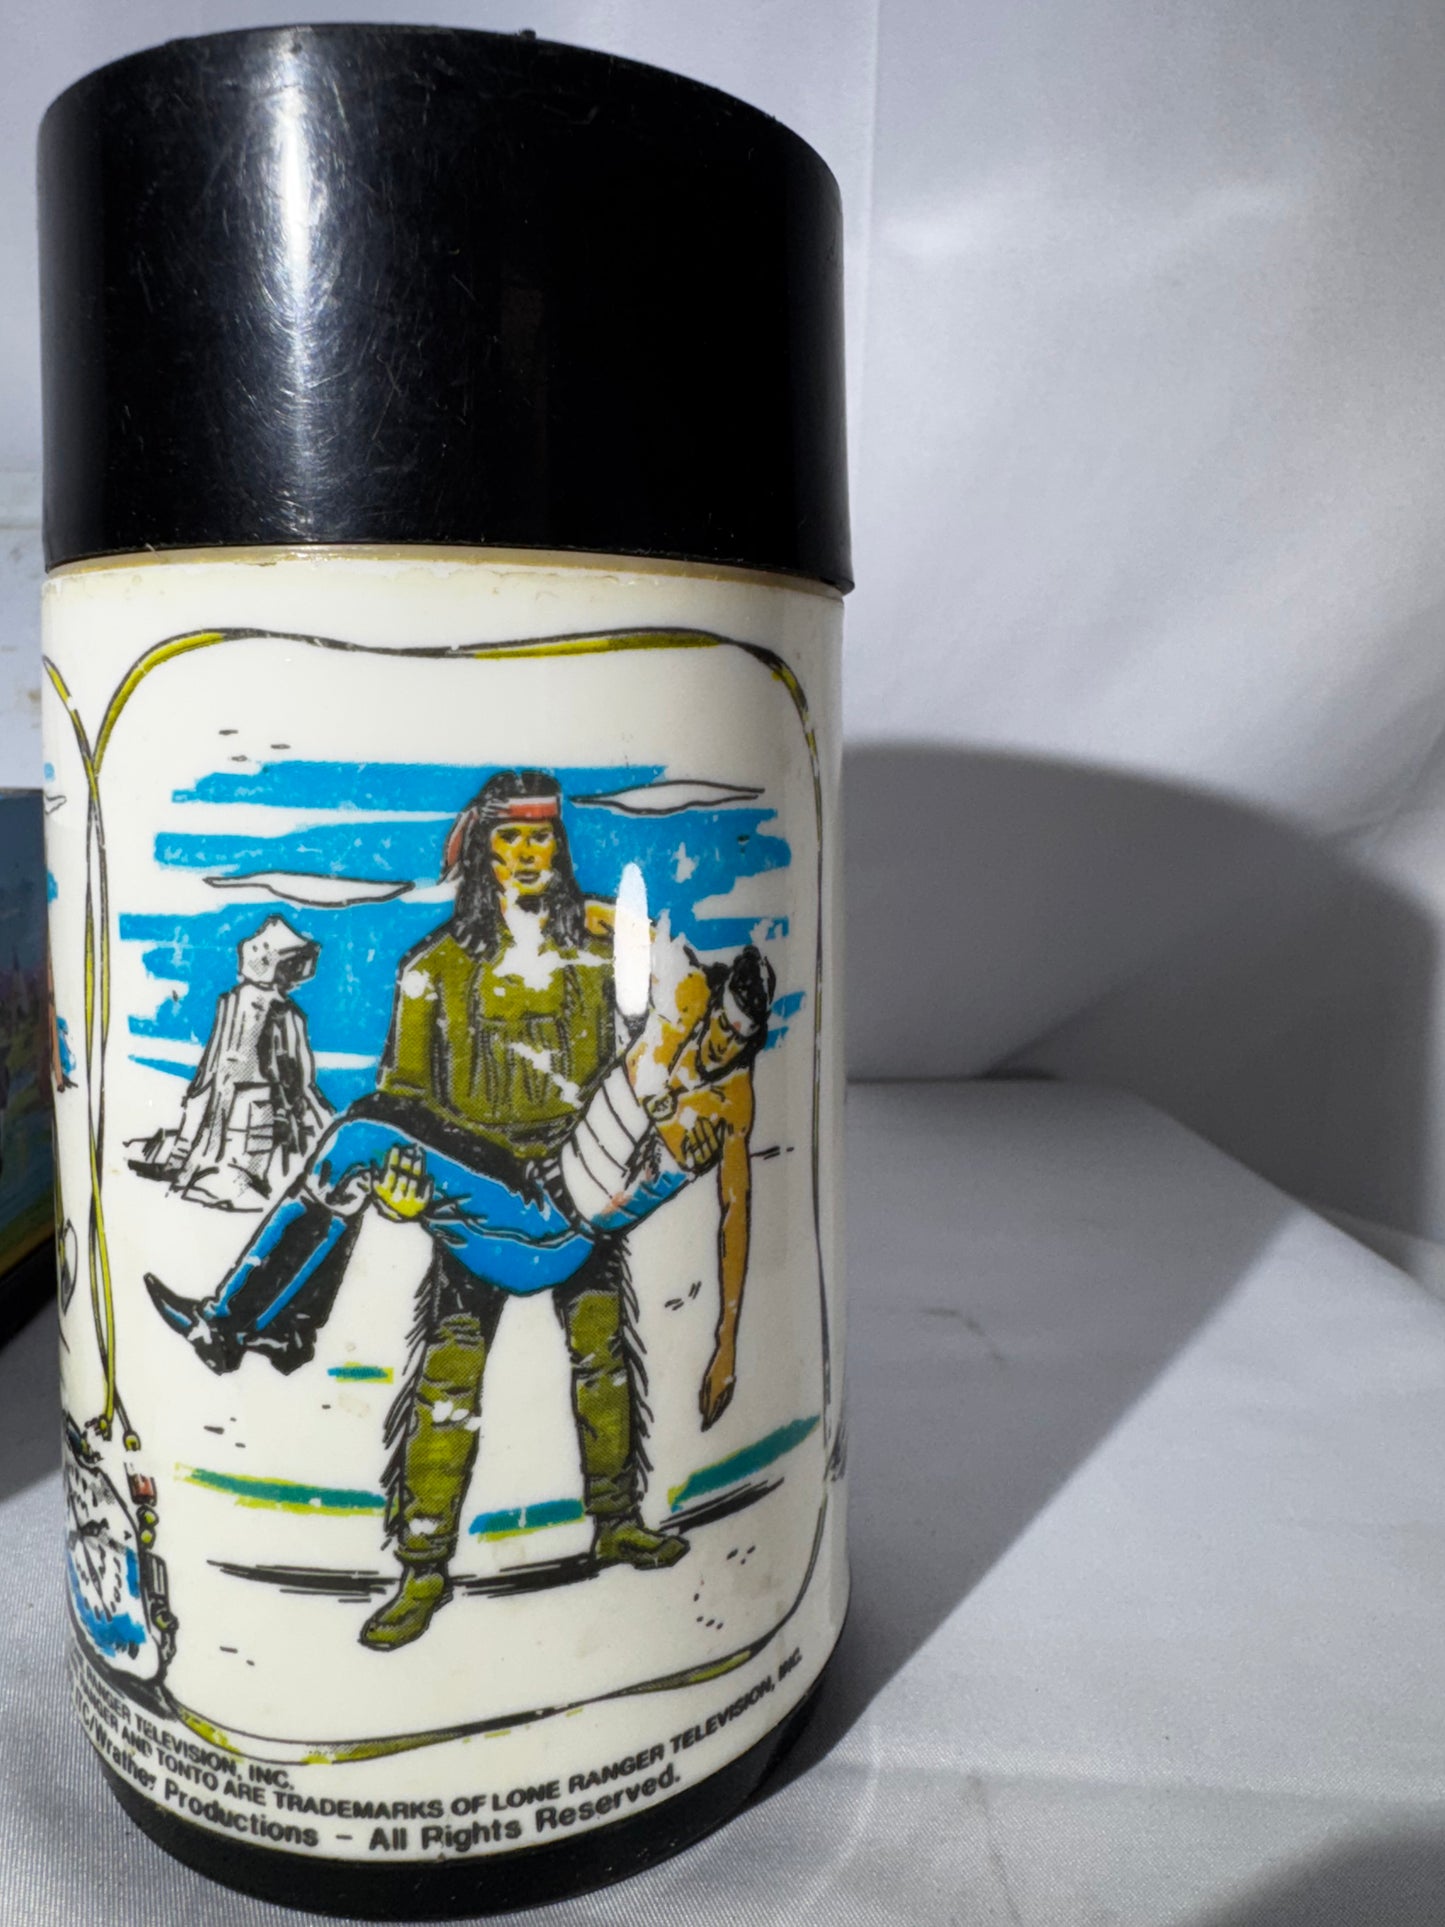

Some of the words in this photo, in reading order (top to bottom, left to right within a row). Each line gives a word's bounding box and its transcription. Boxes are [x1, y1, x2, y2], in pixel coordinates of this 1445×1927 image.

[121, 1725, 153, 1758] AND
[156, 1747, 219, 1792] TONTO
[223, 1779, 267, 1807] ARE
[272, 1790, 445, 1820] TRADEMARKS
[450, 1794, 487, 1817] OF
[491, 1780, 561, 1811] LONE
[568, 1743, 666, 1794] RANGER
[669, 1675, 776, 1755] TELEVISION,
[135, 1713, 242, 1781] TELEVISION,
[248, 1764, 295, 1791] INC.
[164, 1777, 320, 1847] Productions
[368, 1827, 408, 1851] All
[420, 1818, 523, 1852] Rights
[535, 1762, 681, 1833] Reserved.
